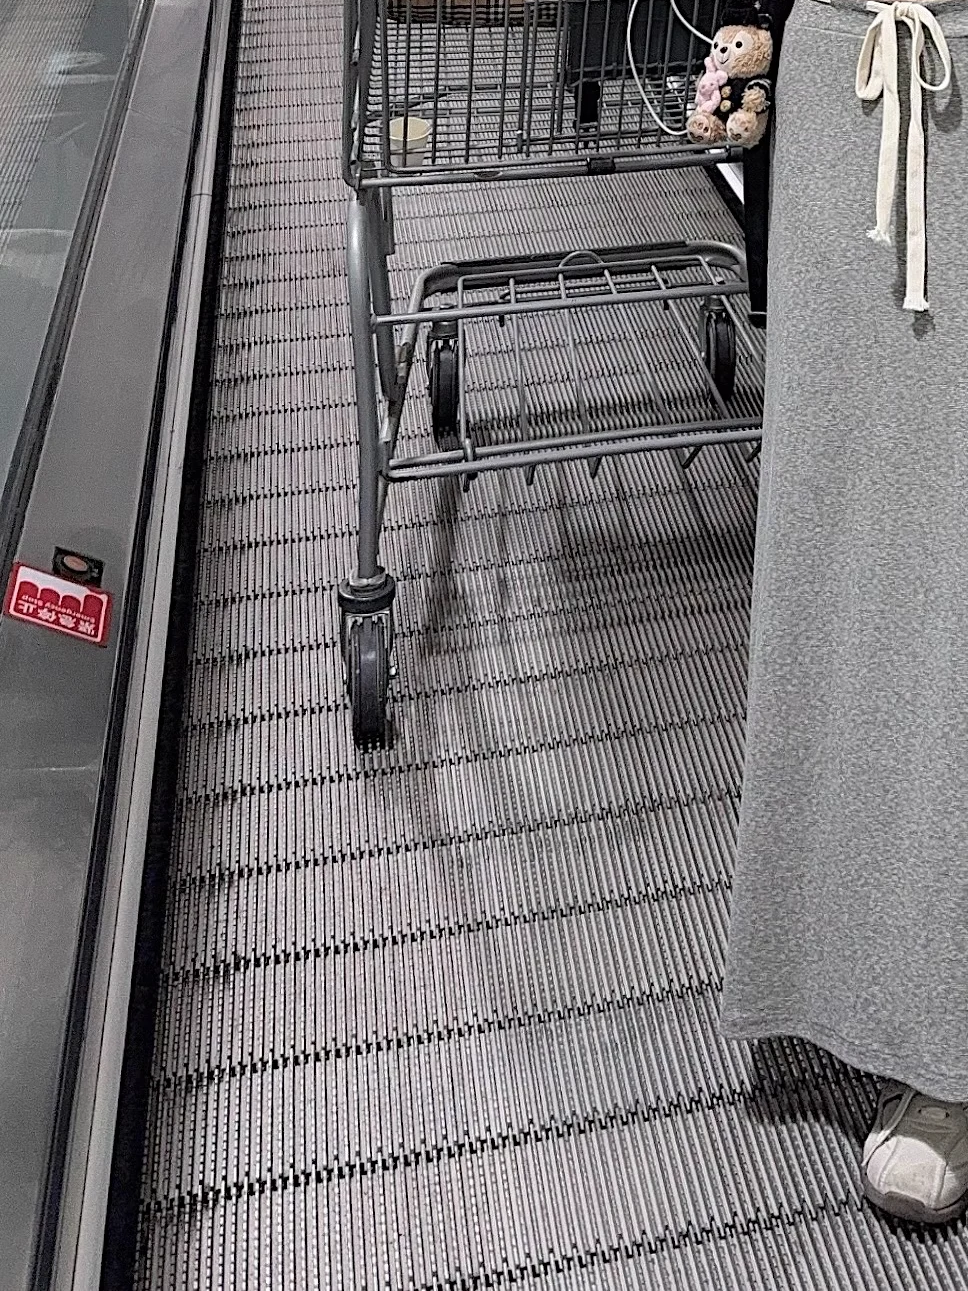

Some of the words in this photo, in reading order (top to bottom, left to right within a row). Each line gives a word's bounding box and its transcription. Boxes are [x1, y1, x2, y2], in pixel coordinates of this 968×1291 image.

[21, 594, 43, 607] Stop
[45, 600, 96, 624] Emergency
[18, 600, 96, 636] 紧急停止
